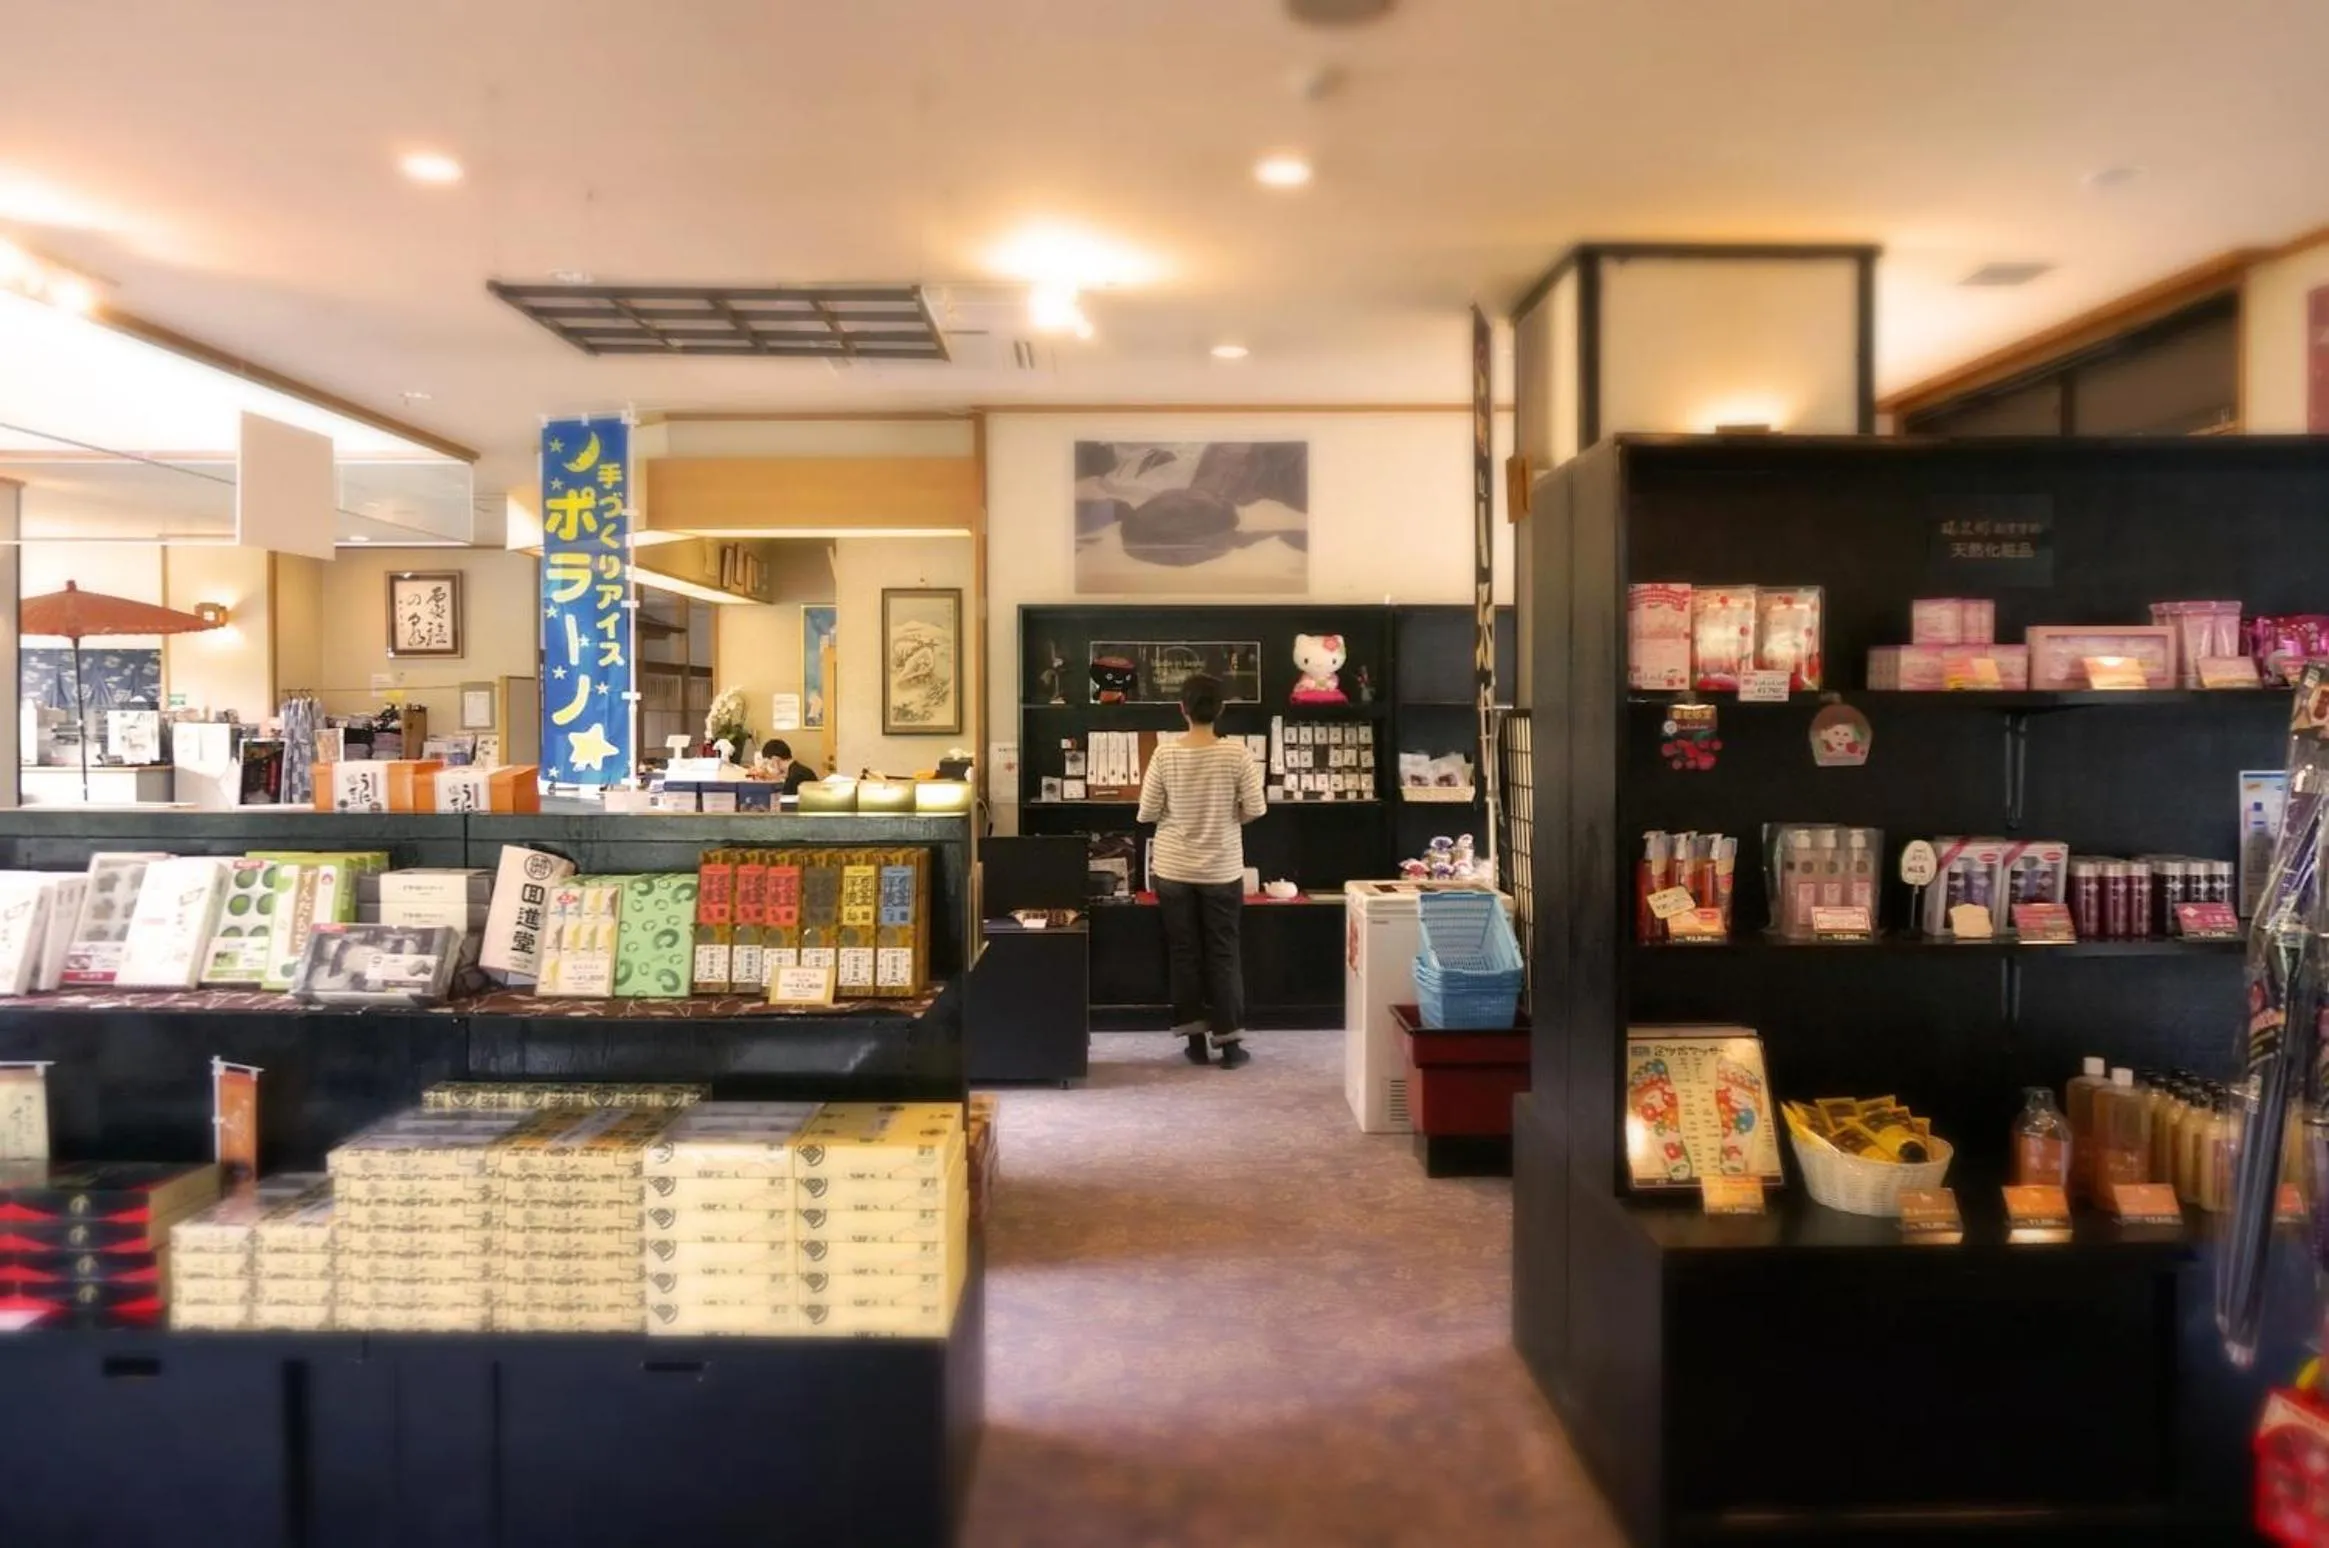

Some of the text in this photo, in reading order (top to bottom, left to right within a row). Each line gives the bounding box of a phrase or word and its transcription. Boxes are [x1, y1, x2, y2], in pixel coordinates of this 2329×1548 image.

[545, 487, 597, 725] ポラーノ
[596, 463, 624, 667] 手づくりアイス
